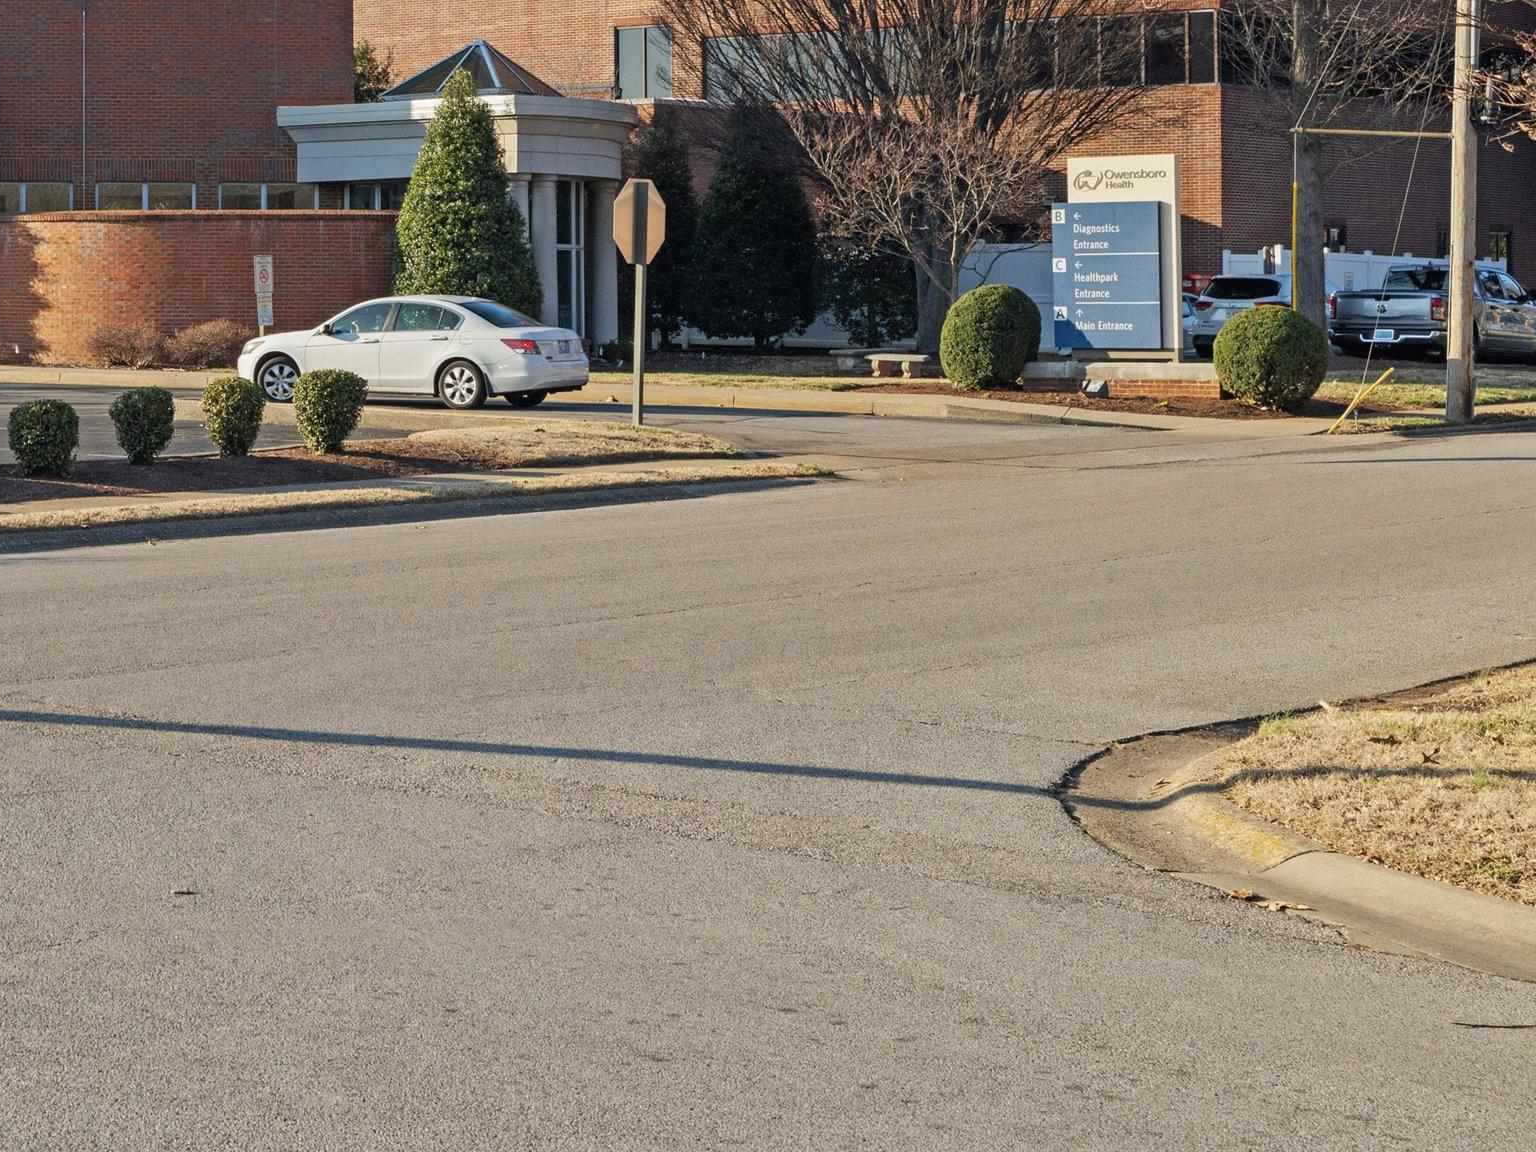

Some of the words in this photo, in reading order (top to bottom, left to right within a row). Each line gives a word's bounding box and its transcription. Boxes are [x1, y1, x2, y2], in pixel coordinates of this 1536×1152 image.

[1104, 168, 1167, 180] Owensboro
[1105, 180, 1135, 189] Health
[1055, 211, 1064, 223] B
[1073, 223, 1121, 235] Diagnostics
[1073, 239, 1110, 249] Entrance
[1055, 259, 1065, 271] C
[1074, 271, 1120, 284] Healthpark
[1074, 288, 1111, 299] Entrance
[1056, 308, 1066, 320] A
[1075, 320, 1096, 330] Main
[1098, 320, 1134, 331] Entrance
